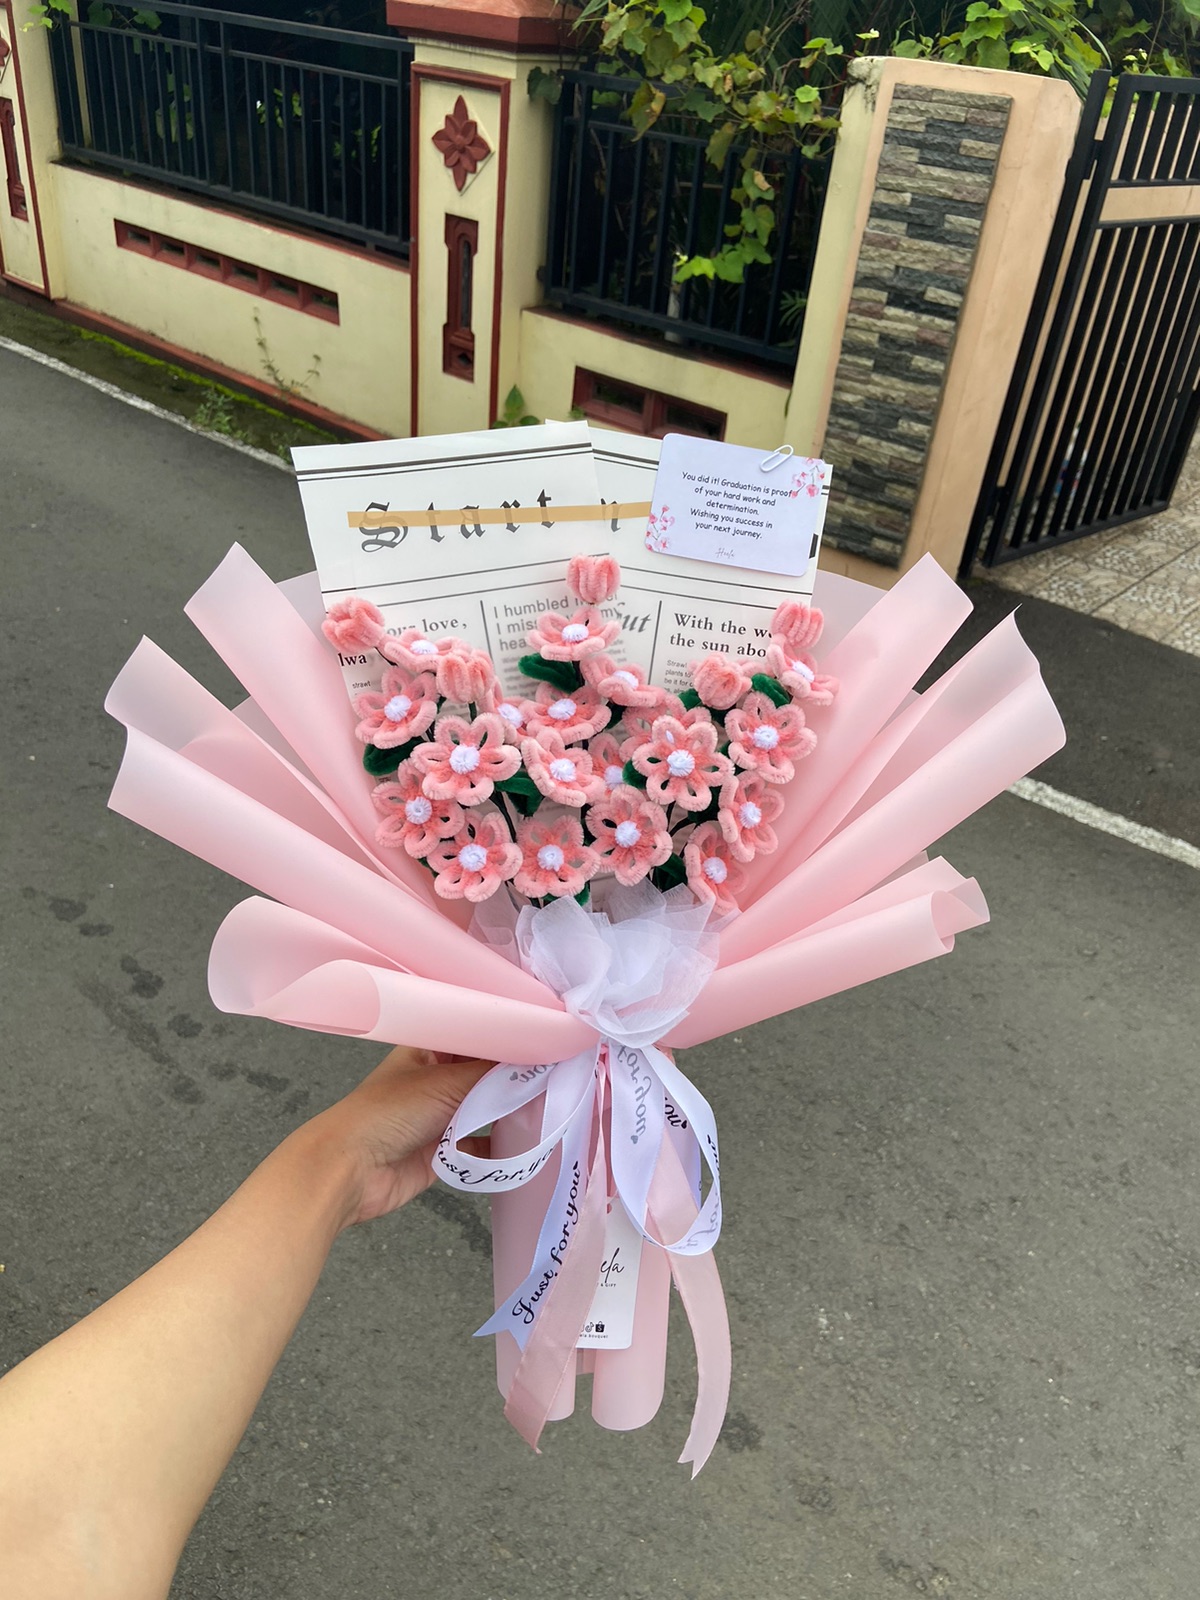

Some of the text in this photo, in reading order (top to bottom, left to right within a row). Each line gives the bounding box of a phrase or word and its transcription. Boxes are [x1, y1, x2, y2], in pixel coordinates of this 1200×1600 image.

[682, 471, 793, 498] You did it! Graduation is proof
[694, 486, 776, 507] of your hard work and
[706, 499, 759, 516] determination.
[358, 489, 555, 552] Start
[690, 508, 719, 522] Wishing
[720, 515, 734, 523] you
[735, 517, 764, 528] success
[695, 522, 763, 540] your next journey.
[493, 606, 498, 619] I
[504, 596, 569, 618] humbled
[422, 618, 468, 633] love,
[496, 623, 501, 635] I
[674, 612, 714, 631] With
[720, 620, 747, 635] the
[500, 638, 527, 651] hea
[670, 633, 766, 658] the sun abo
[338, 653, 367, 667] lwa
[664, 1099, 682, 1128] ou
[463, 1169, 523, 1185] for
[511, 1169, 581, 1325] Just for you
